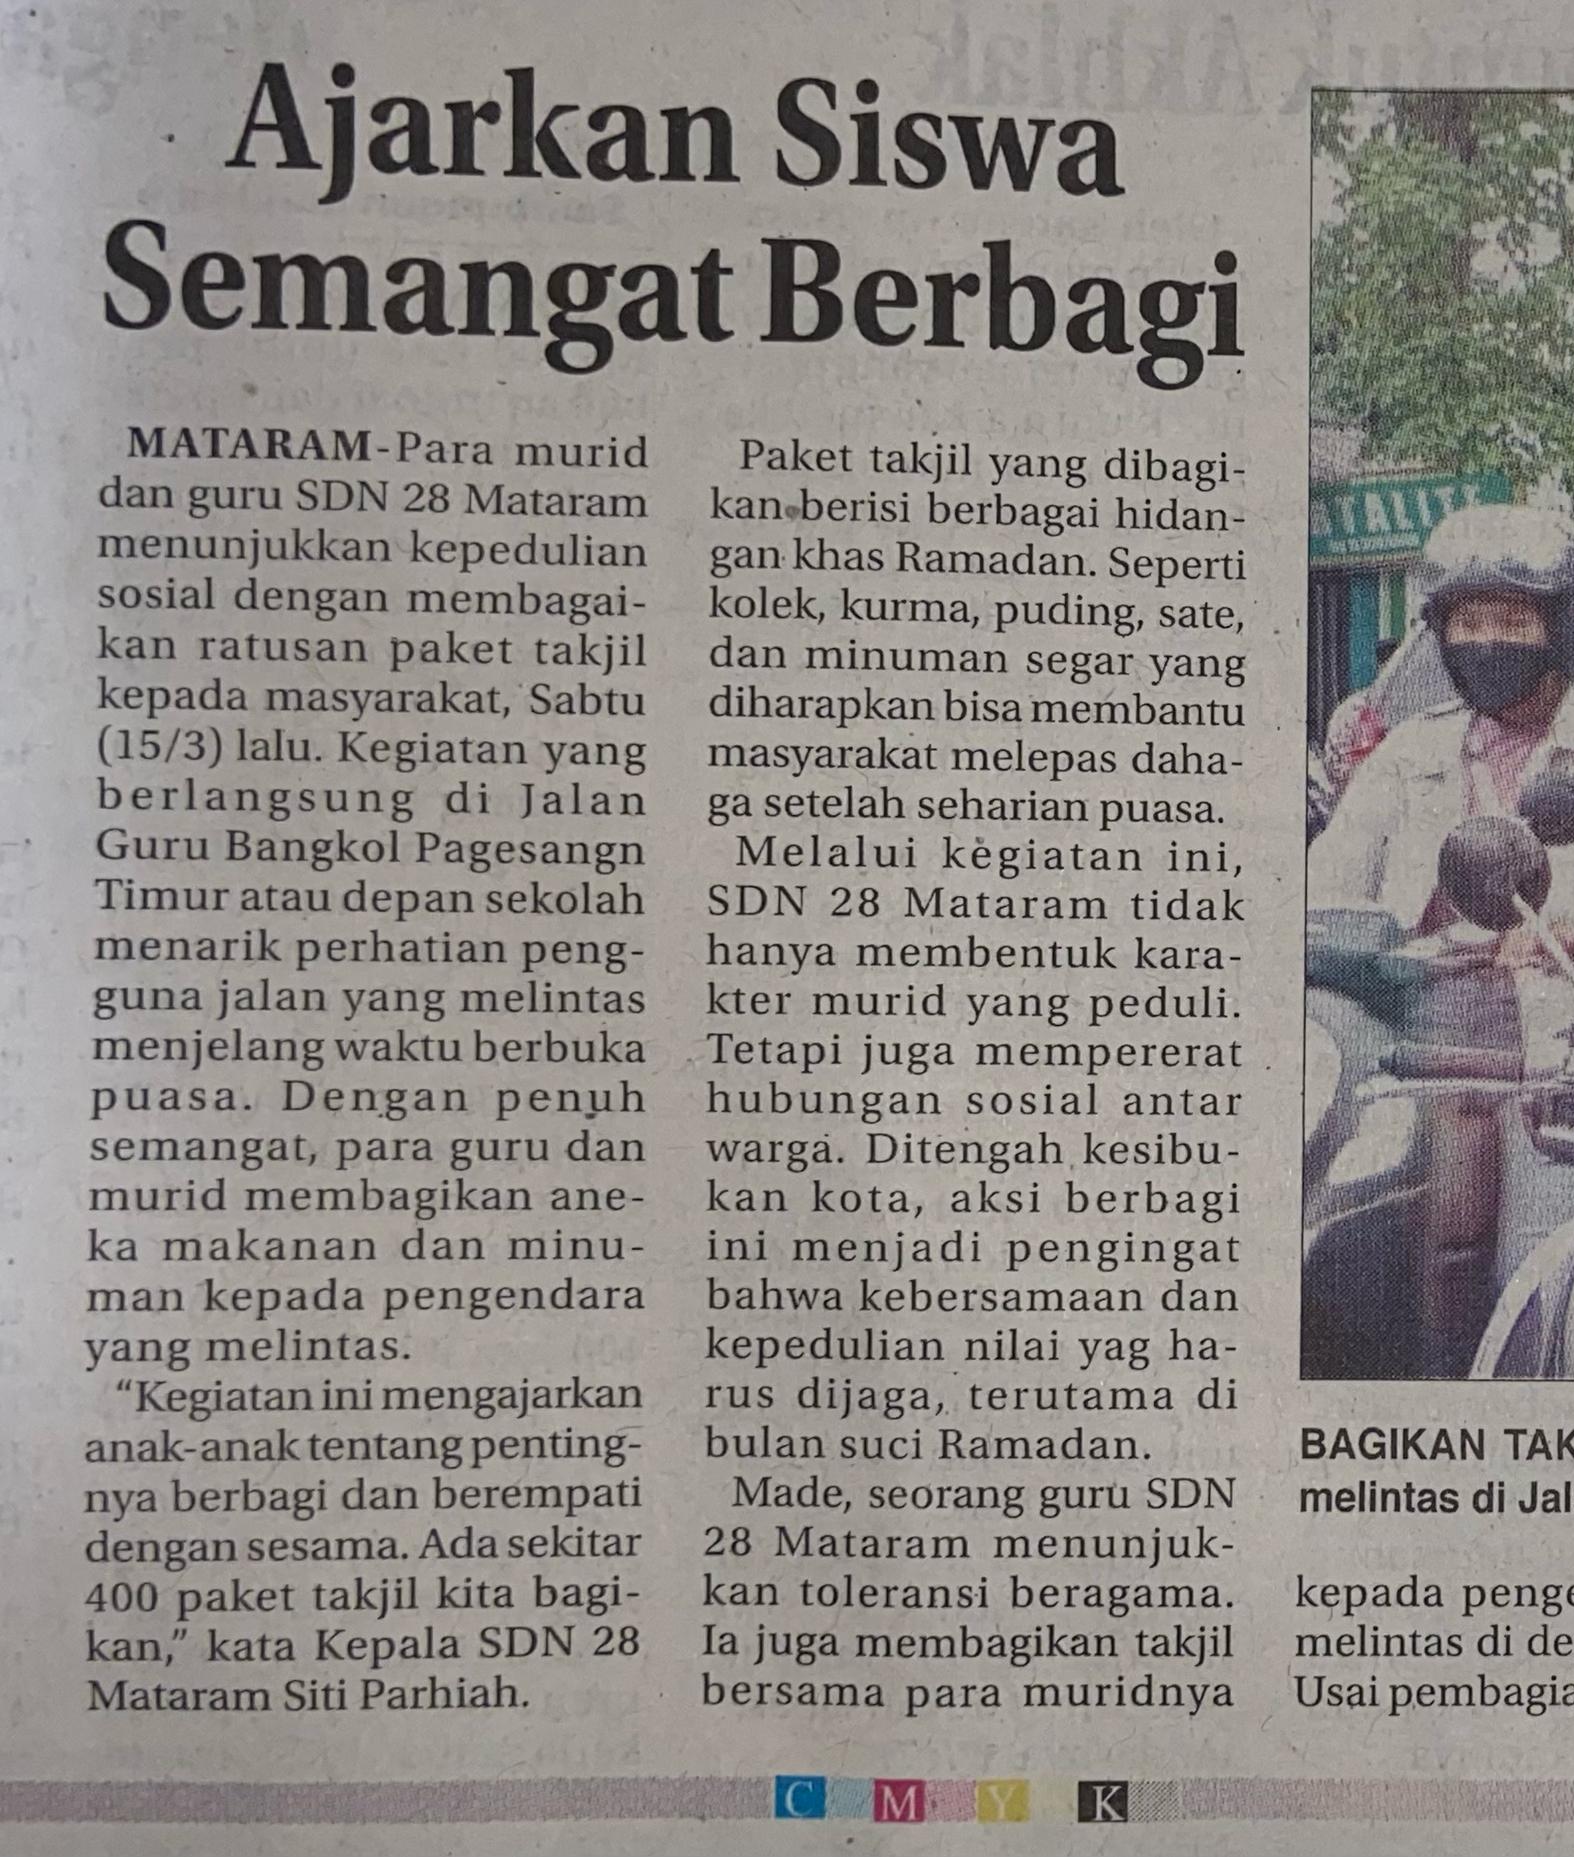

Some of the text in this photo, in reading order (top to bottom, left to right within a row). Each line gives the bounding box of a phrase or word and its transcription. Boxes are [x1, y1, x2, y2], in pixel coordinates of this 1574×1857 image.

[225, 63, 1125, 204] Ajarkan Siswa
[104, 219, 1244, 390] Semangat Berbagi
[128, 426, 647, 468] MATARAM-Para murid
[741, 438, 1245, 492] Paket takjil yang dibagi-
[99, 528, 646, 573] menunjukkan kepedulian
[710, 537, 1246, 588] gan khas Ramadan. Seperti
[710, 585, 1243, 638] kolek, kurma, puding, sate,
[98, 626, 645, 675] kan ratusan paket takjil
[98, 725, 646, 776] (15/3) lalu. Kegiatan yang
[709, 737, 1242, 781] masyarakat melepas daha-
[96, 828, 644, 875] Guru Bangkol Pagesangn
[736, 834, 1241, 880] Melalui kegiatan ini,
[93, 978, 645, 1022] guna jalan yang melintas
[707, 981, 1240, 1027] kter murid yang peduli.
[91, 1080, 644, 1121] puasa. Dengan penuh
[708, 1081, 1242, 1124] hubungan sosial antar
[90, 1178, 644, 1220] murid membagikan ane-
[708, 1179, 1239, 1223] kan kota, aksi berbagi
[706, 1326, 1236, 1371] kepedulian nilai yag ha-
[117, 1376, 642, 1422] “Kegiatan ini mengajarkan
[1302, 1427, 1484, 1460] BAGIKAN
[733, 1475, 1236, 1519] Made, seorang guru SDN
[1300, 1480, 1459, 1513] melintas
[1472, 1481, 1505, 1514] di
[85, 1525, 642, 1572] dengan sesama. Ada sekitar
[703, 1573, 1233, 1618] kan toleransi beragama.
[1296, 1574, 1443, 1617] kepada
[87, 1625, 639, 1670] kan,” kata Kepala SDN 28
[1296, 1624, 1463, 1657] melintas
[1477, 1624, 1512, 1657] di
[88, 1675, 528, 1711] Mataram Siti Parhiah.
[702, 1672, 1233, 1717] bersama para muridnya
[1294, 1675, 1379, 1709] Usai
[784, 1780, 1126, 1822] C M Y K
